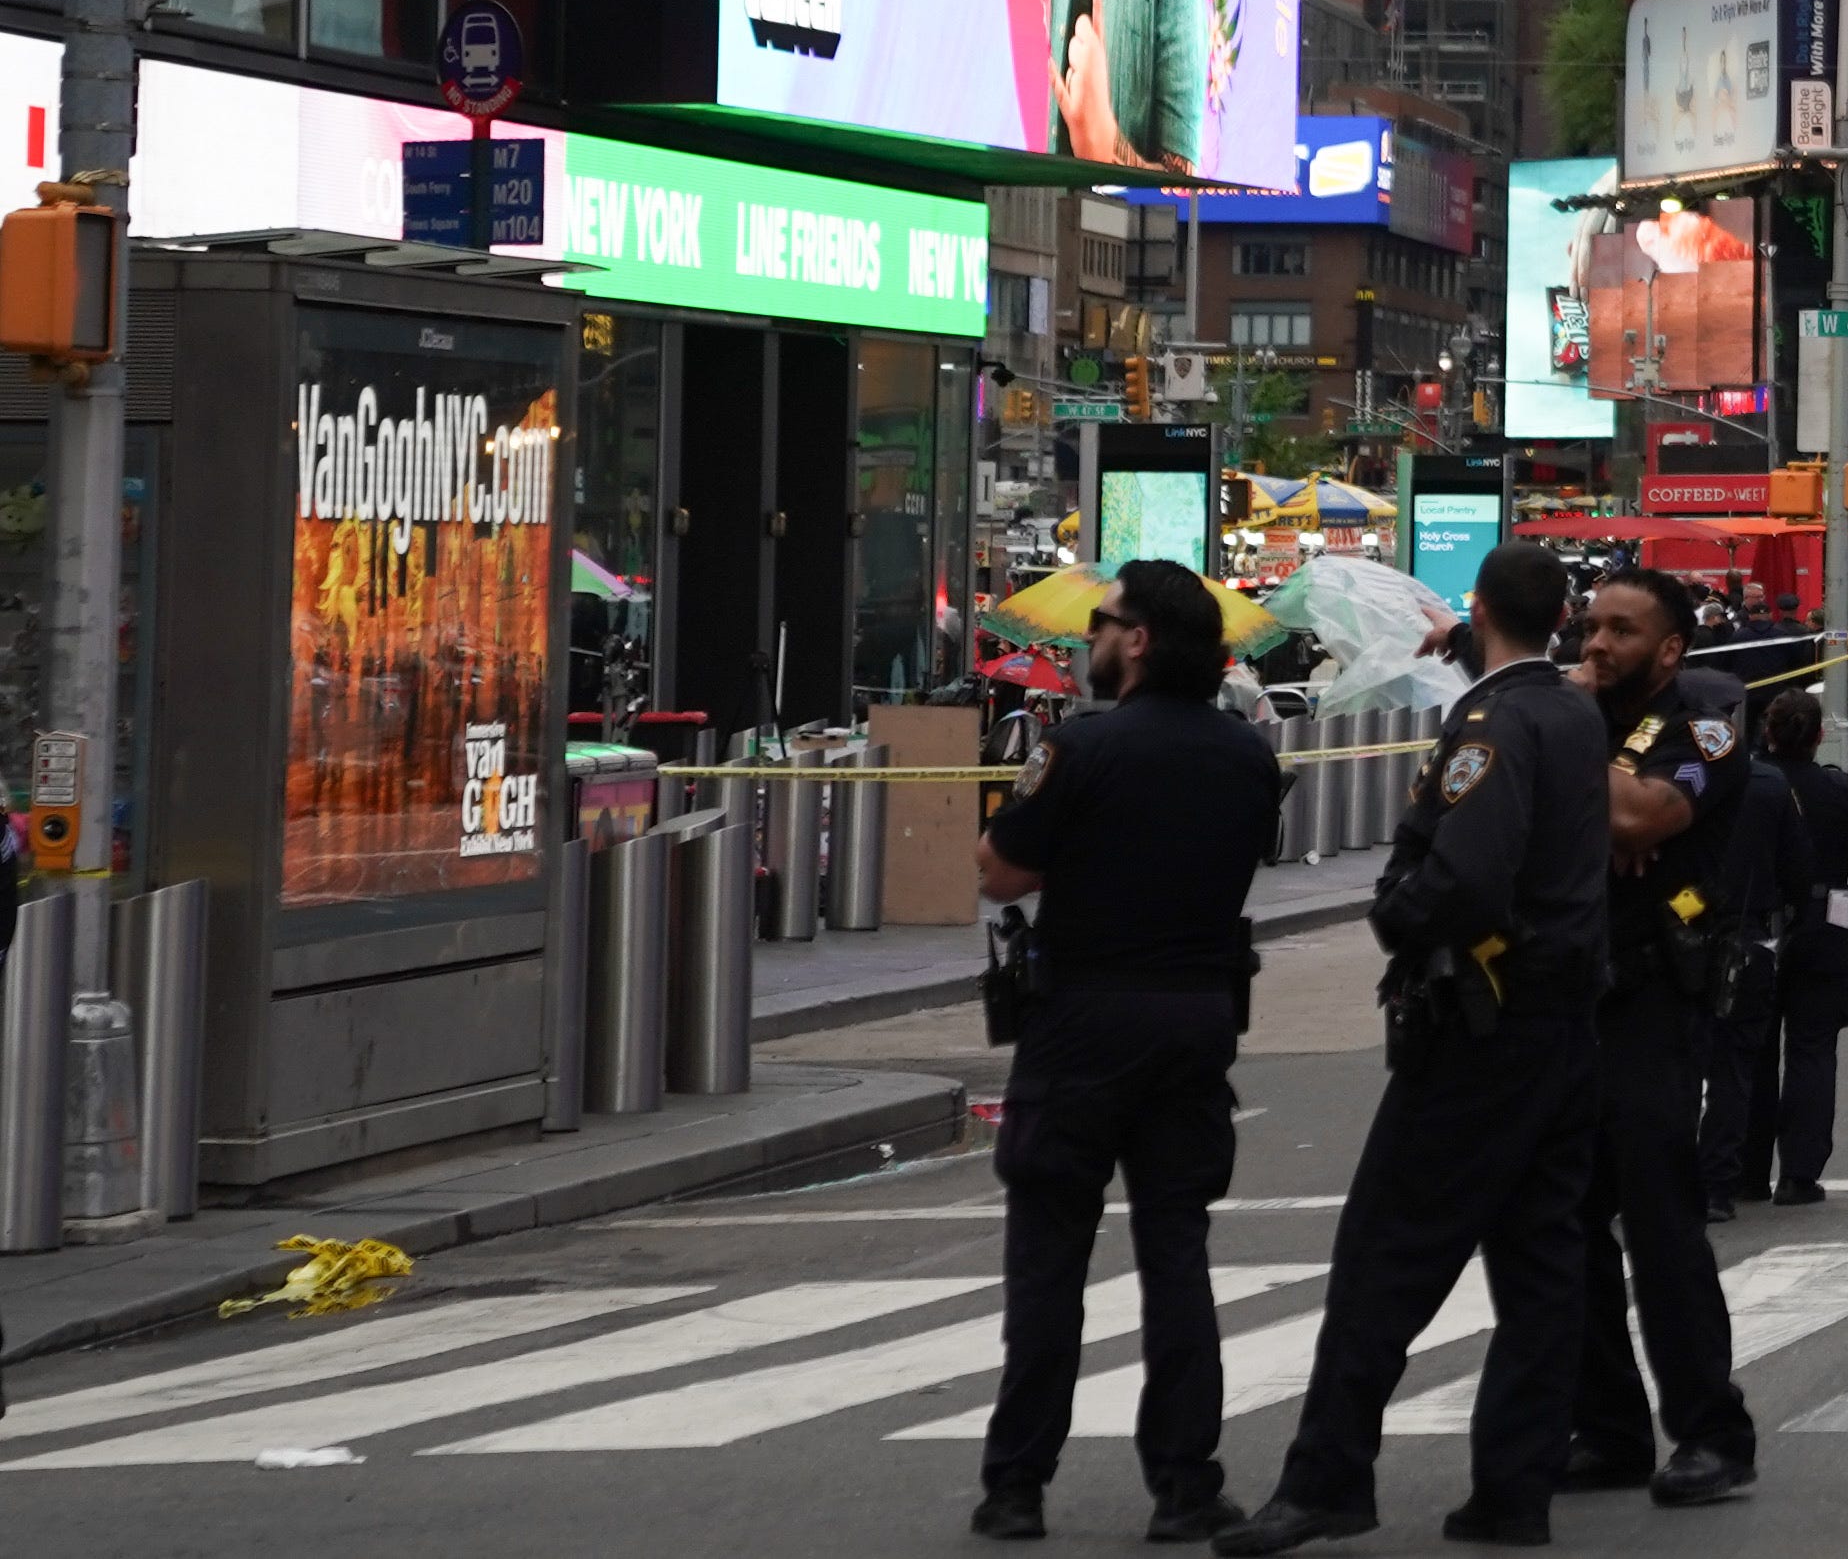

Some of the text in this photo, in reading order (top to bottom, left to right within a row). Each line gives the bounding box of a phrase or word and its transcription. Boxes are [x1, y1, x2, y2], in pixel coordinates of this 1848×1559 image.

[1811, 1, 1824, 42] More
[1811, 42, 1824, 76] With
[1797, 87, 1810, 145] Breathe
[1811, 87, 1827, 125] Right
[493, 143, 520, 169] M7
[493, 179, 532, 205] M20
[492, 215, 540, 242] M104
[562, 174, 629, 259] NEW
[633, 184, 703, 270] YORK
[735, 201, 787, 280] LINE
[789, 209, 881, 293] FRIENDS
[908, 227, 959, 300] NEW
[1821, 313, 1838, 334] W
[1164, 426, 1208, 439] LinkNYC
[298, 382, 550, 555] VanGoghNYC.com
[1465, 458, 1501, 468] LinkNYC
[1648, 488, 1726, 502] COFFEED
[1419, 504, 1477, 518] Local Pantry
[1418, 540, 1455, 552] Church
[1419, 530, 1471, 544] Holy Cross
